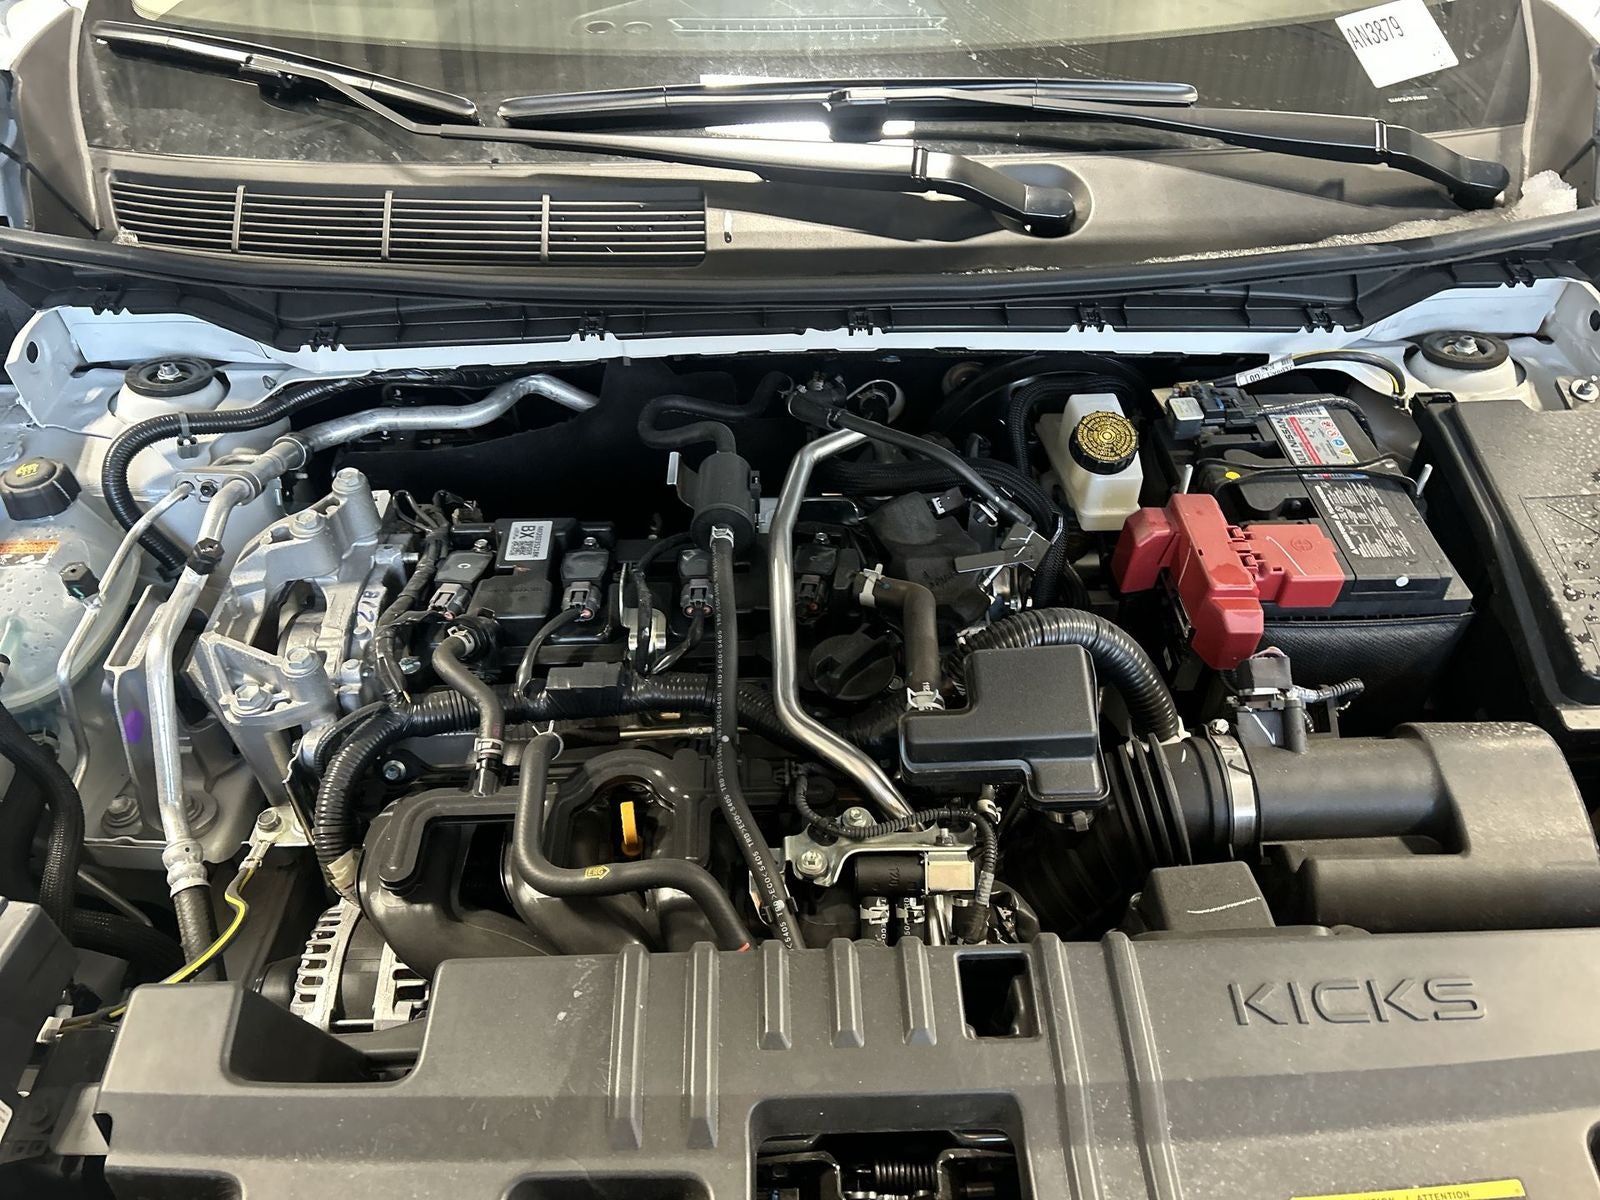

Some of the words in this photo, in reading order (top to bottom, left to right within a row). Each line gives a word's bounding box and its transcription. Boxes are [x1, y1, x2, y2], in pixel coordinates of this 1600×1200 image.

[1346, 16, 1404, 50] AN3879
[1277, 418, 1298, 448] NISSAN
[519, 525, 536, 539] BX
[1227, 976, 1488, 1025] KICKS
[1417, 1190, 1470, 1200] ATTENTION
